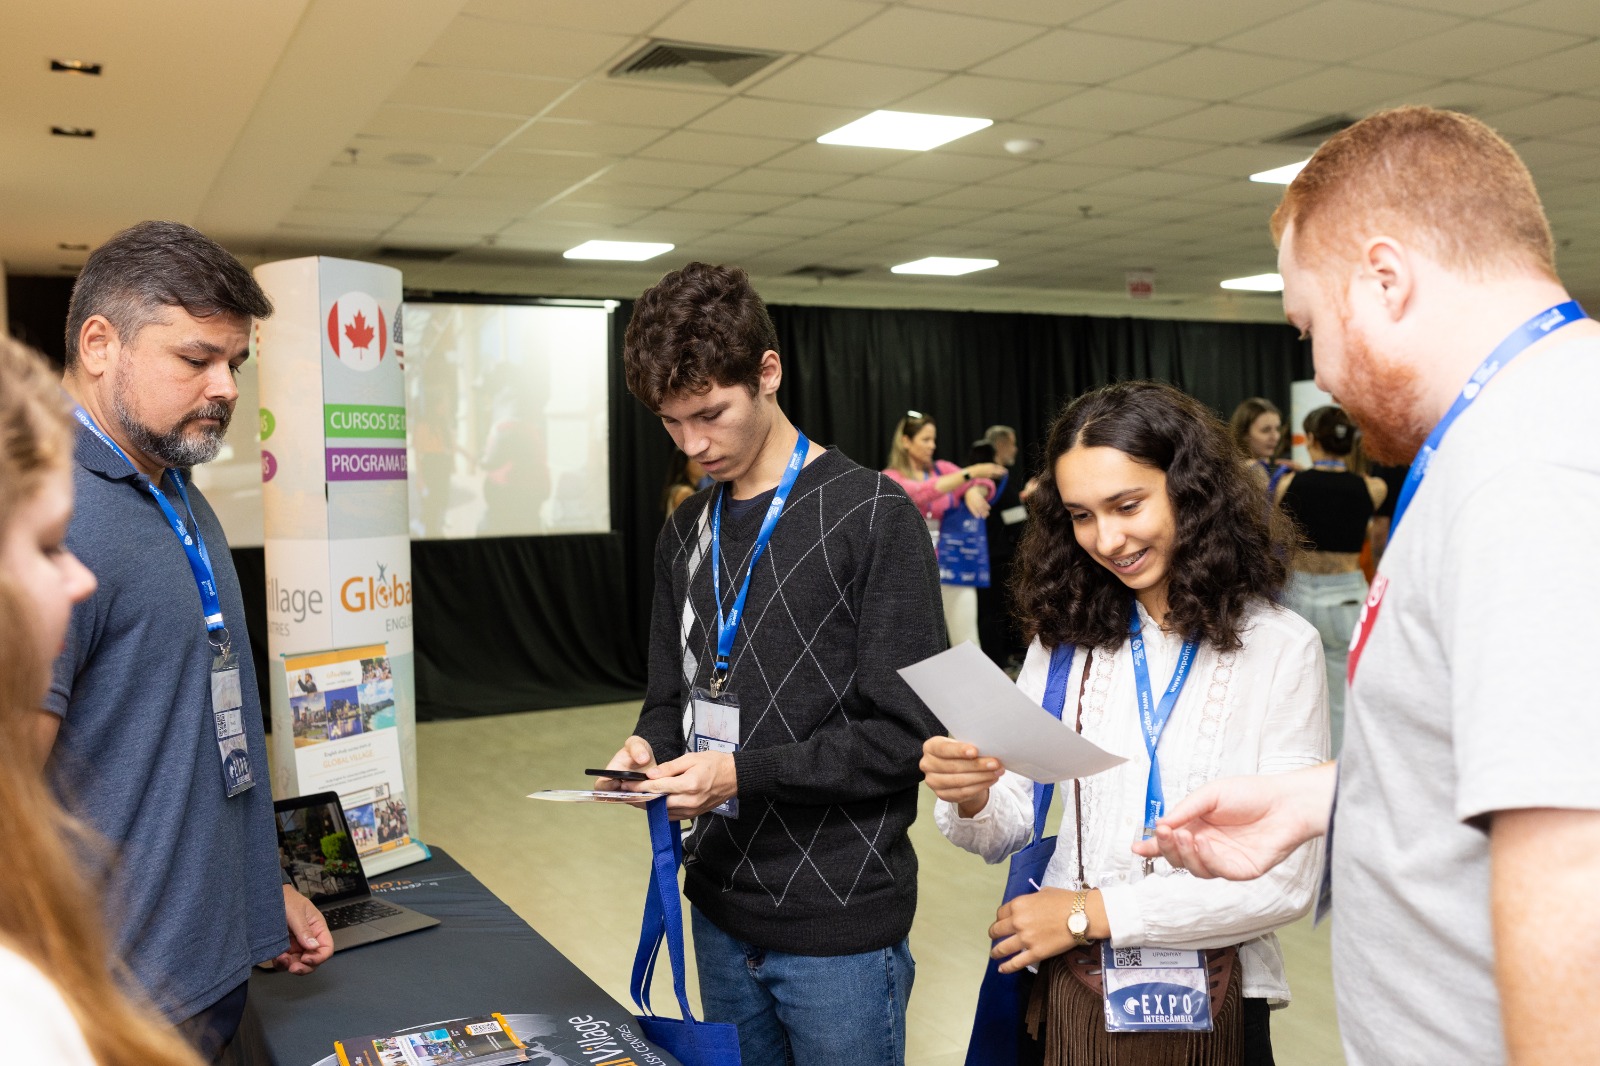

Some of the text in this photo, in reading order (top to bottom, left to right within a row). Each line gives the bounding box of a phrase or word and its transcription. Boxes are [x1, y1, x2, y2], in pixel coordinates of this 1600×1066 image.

[330, 411, 386, 430] CURSOS
[388, 413, 400, 430] DE
[332, 454, 400, 473] PROGRAMA
[324, 750, 373, 768] GLOBAL VILLAGE
[1141, 994, 1192, 1015] EXPO
[568, 1014, 625, 1063] Village
